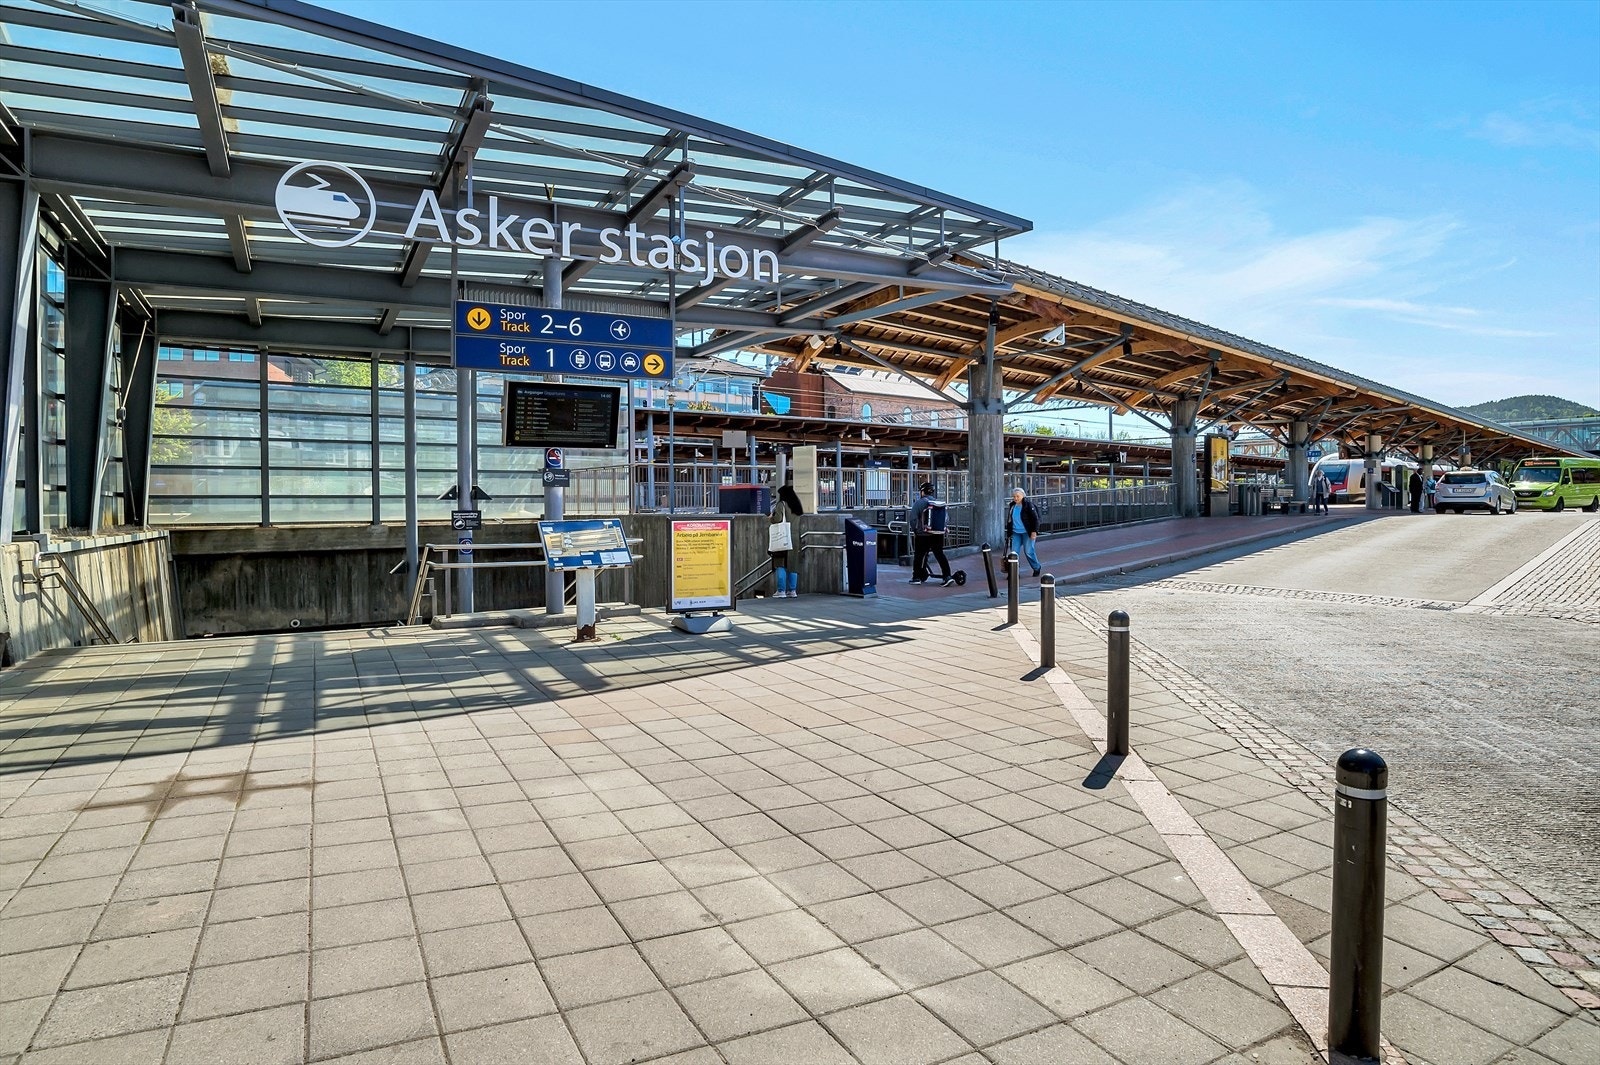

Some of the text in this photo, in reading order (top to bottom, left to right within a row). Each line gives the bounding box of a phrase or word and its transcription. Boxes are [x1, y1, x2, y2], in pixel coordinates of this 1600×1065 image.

[404, 189, 779, 286] Asker stasjon
[500, 308, 526, 321] Spor
[500, 320, 530, 332] Track
[499, 342, 526, 355] Spor
[499, 354, 530, 366] Track
[546, 348, 554, 368] 1
